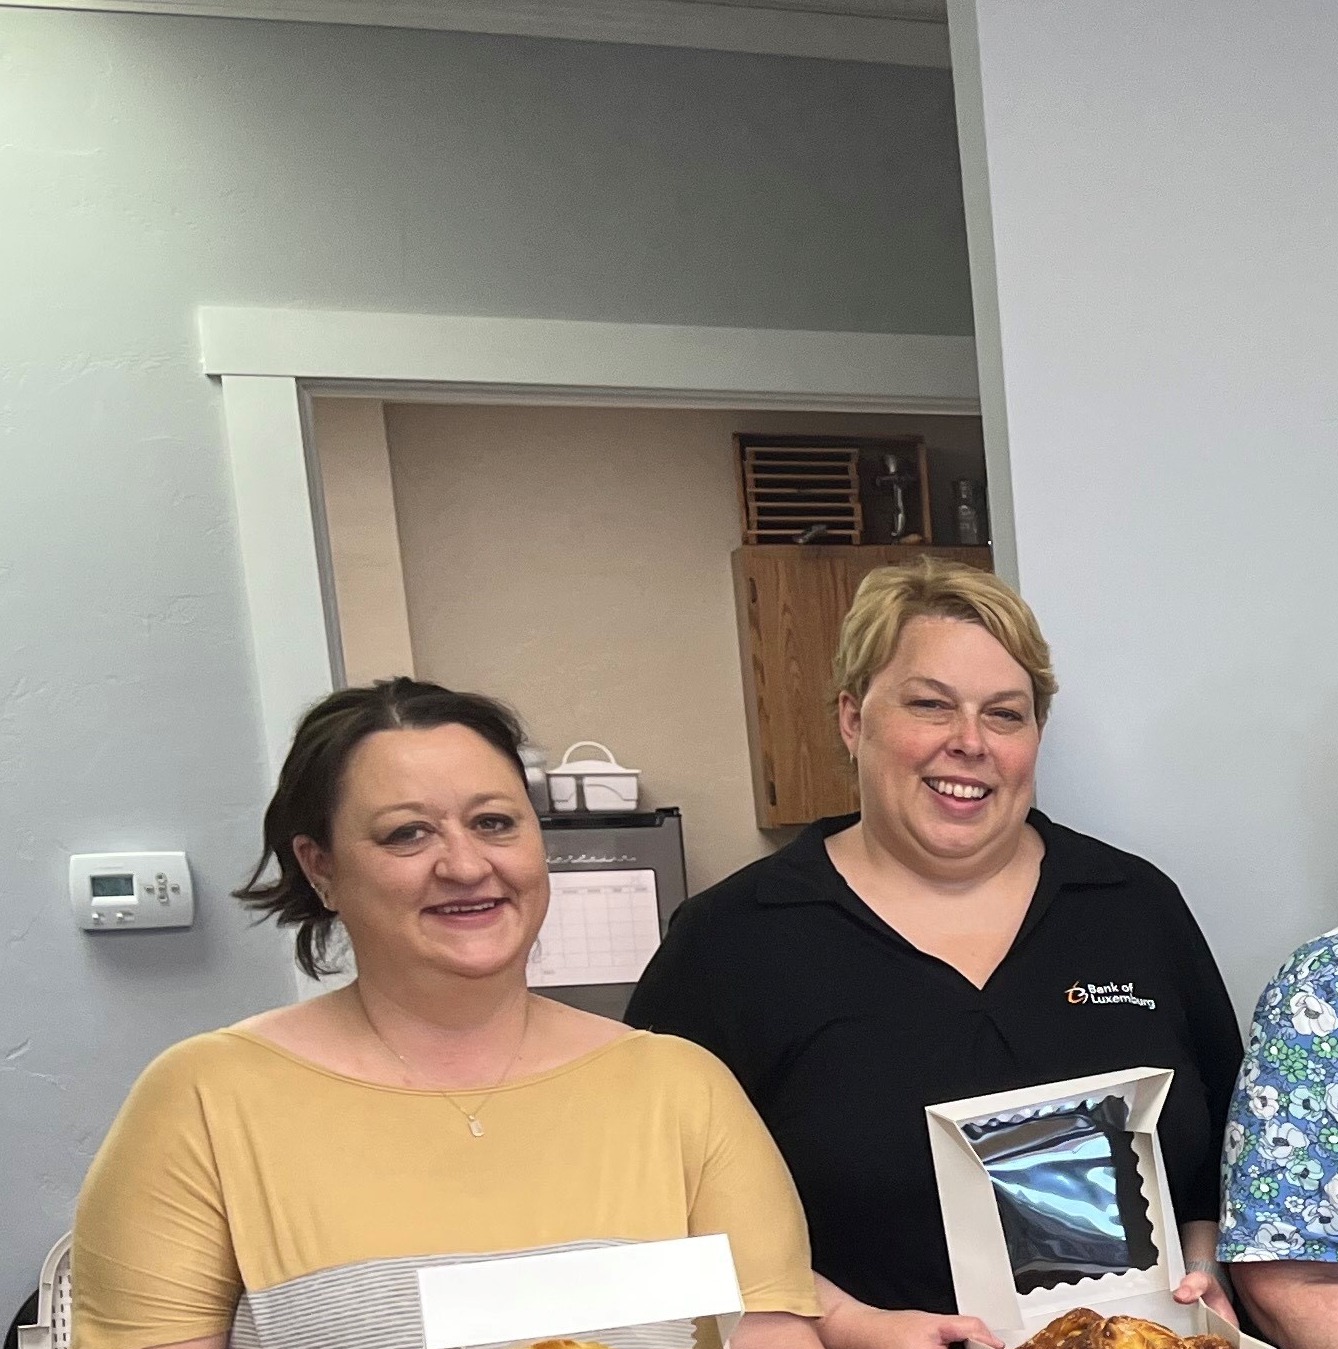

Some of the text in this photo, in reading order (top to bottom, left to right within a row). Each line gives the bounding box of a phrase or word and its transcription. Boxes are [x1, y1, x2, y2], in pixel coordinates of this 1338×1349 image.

[1087, 982, 1134, 994] Bank of
[1090, 993, 1156, 1010] Luxemburg
